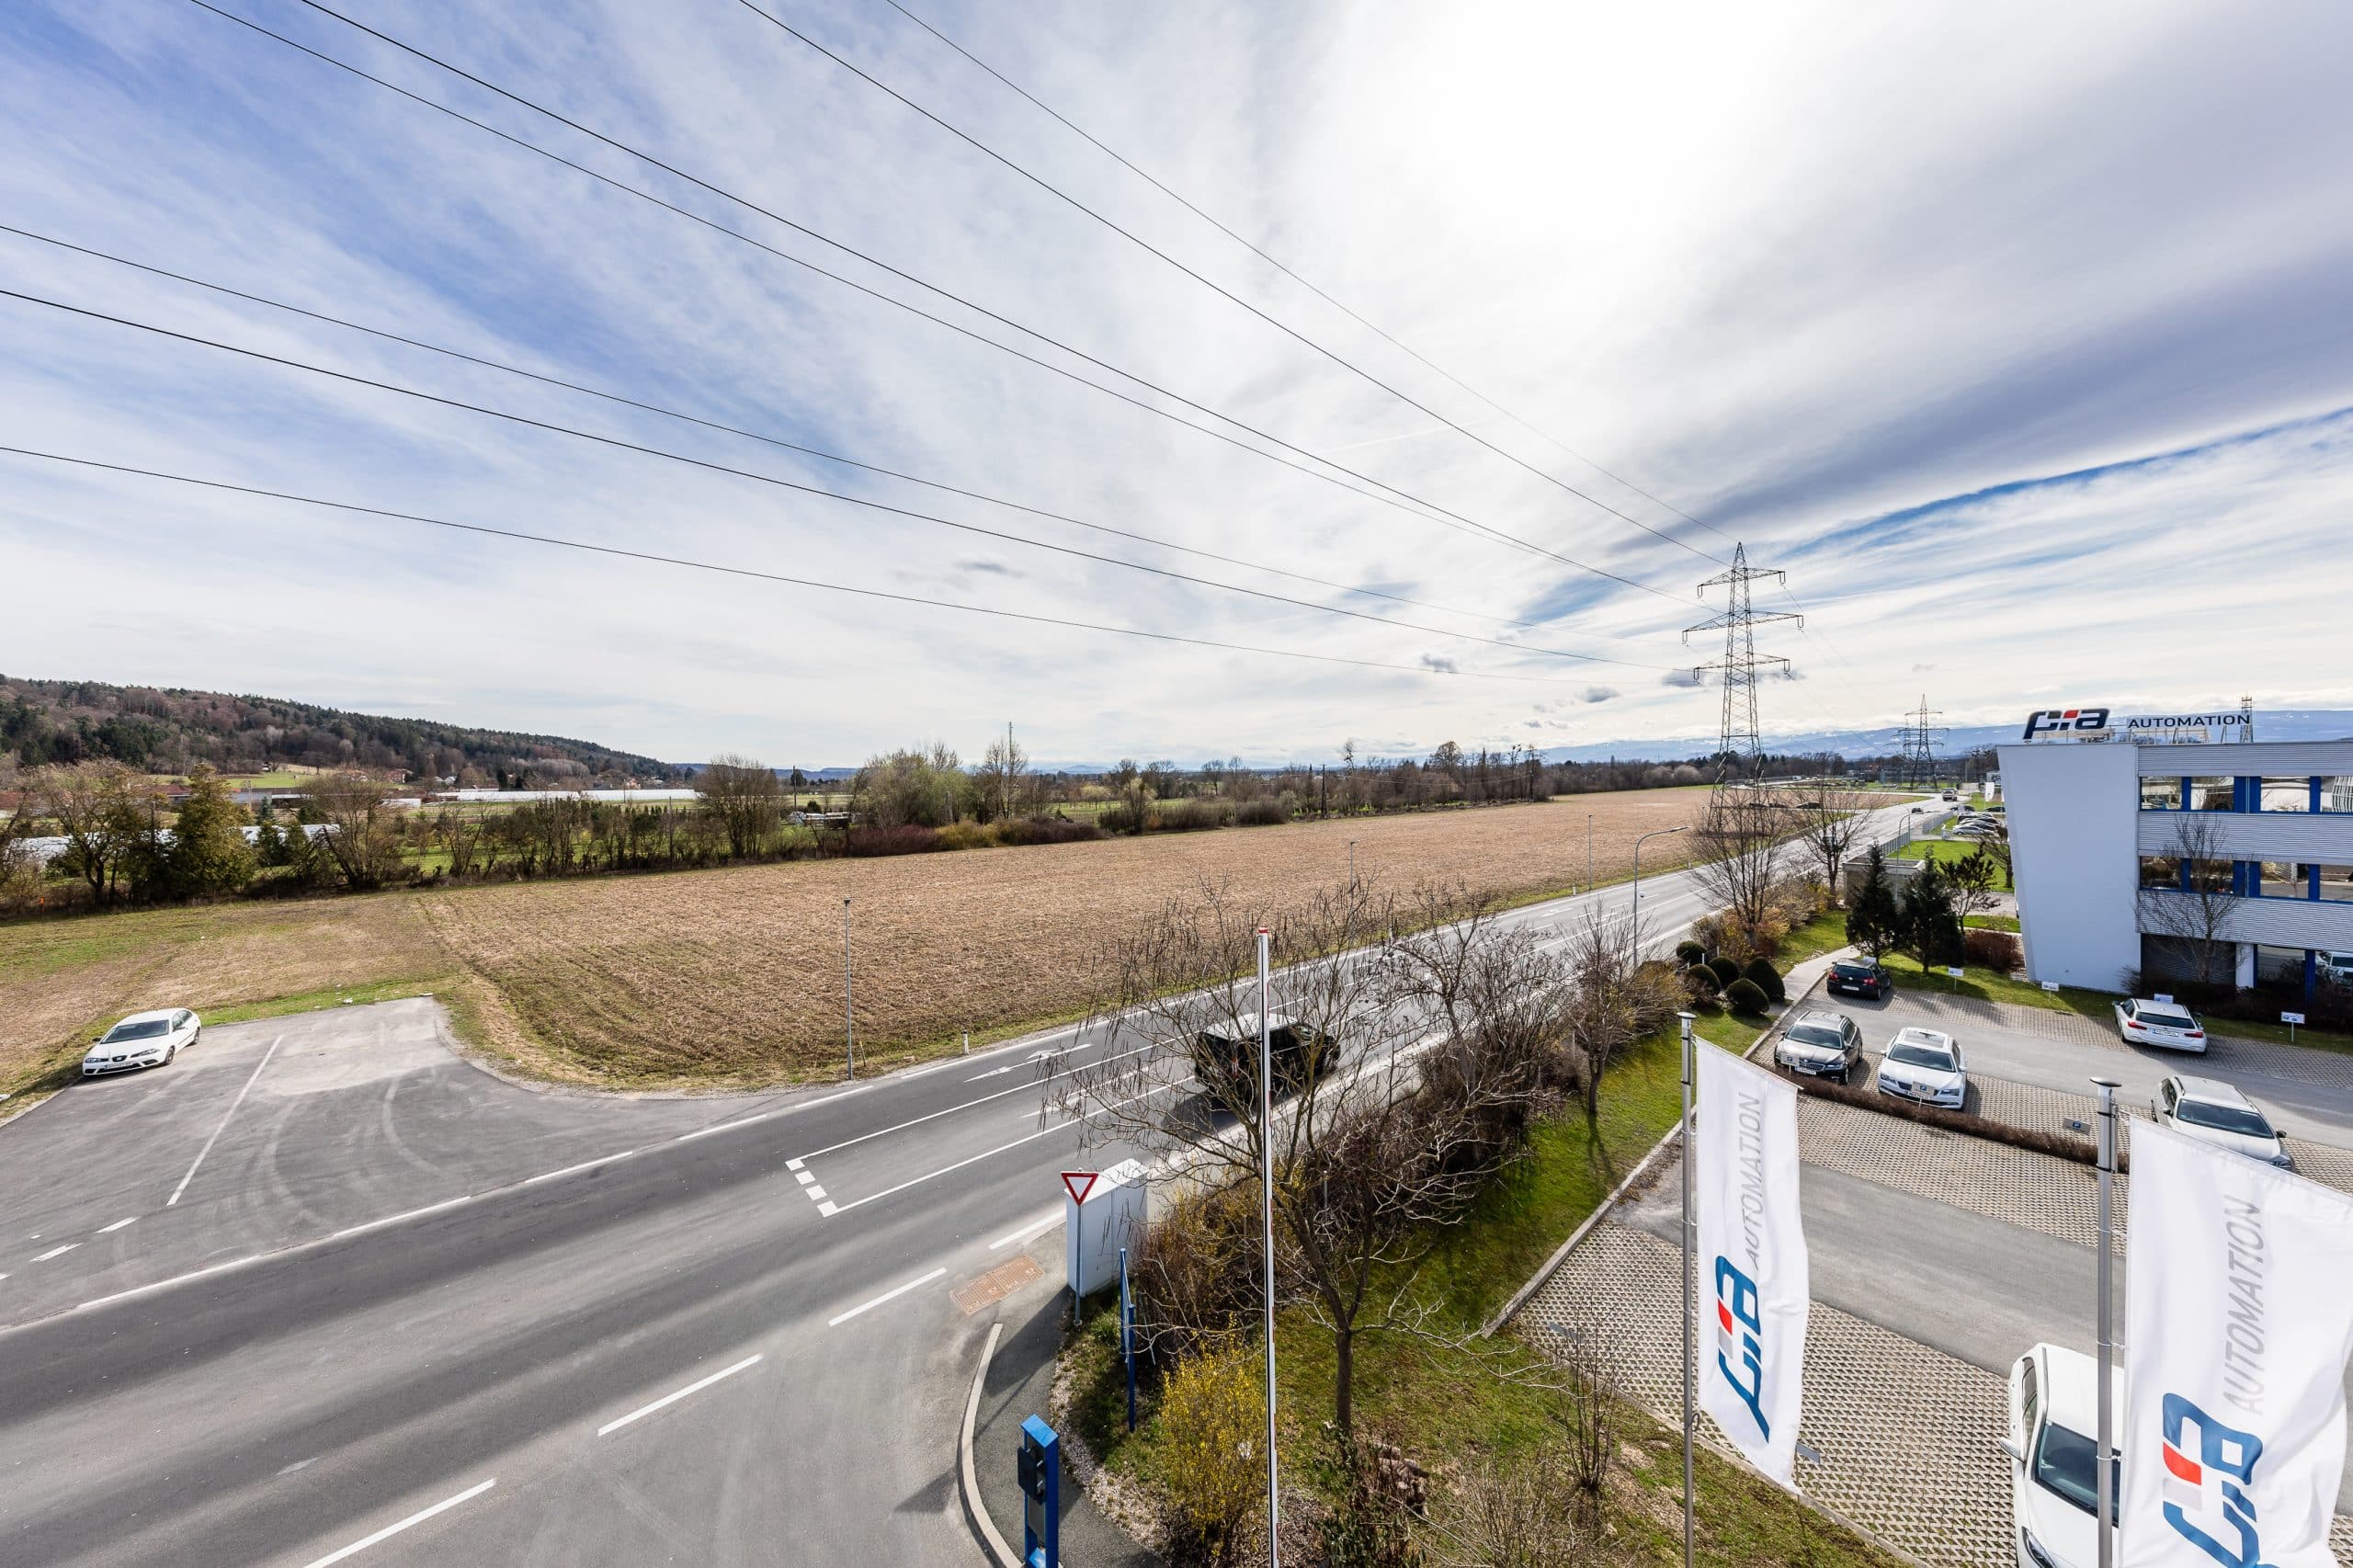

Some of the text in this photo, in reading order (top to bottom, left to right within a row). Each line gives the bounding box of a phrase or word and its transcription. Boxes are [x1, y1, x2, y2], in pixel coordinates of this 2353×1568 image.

[2127, 714, 2251, 729] AUTOMATION
[1738, 1093, 1762, 1271] AUTOMATION
[2222, 1195, 2266, 1416] AUTOMATION
